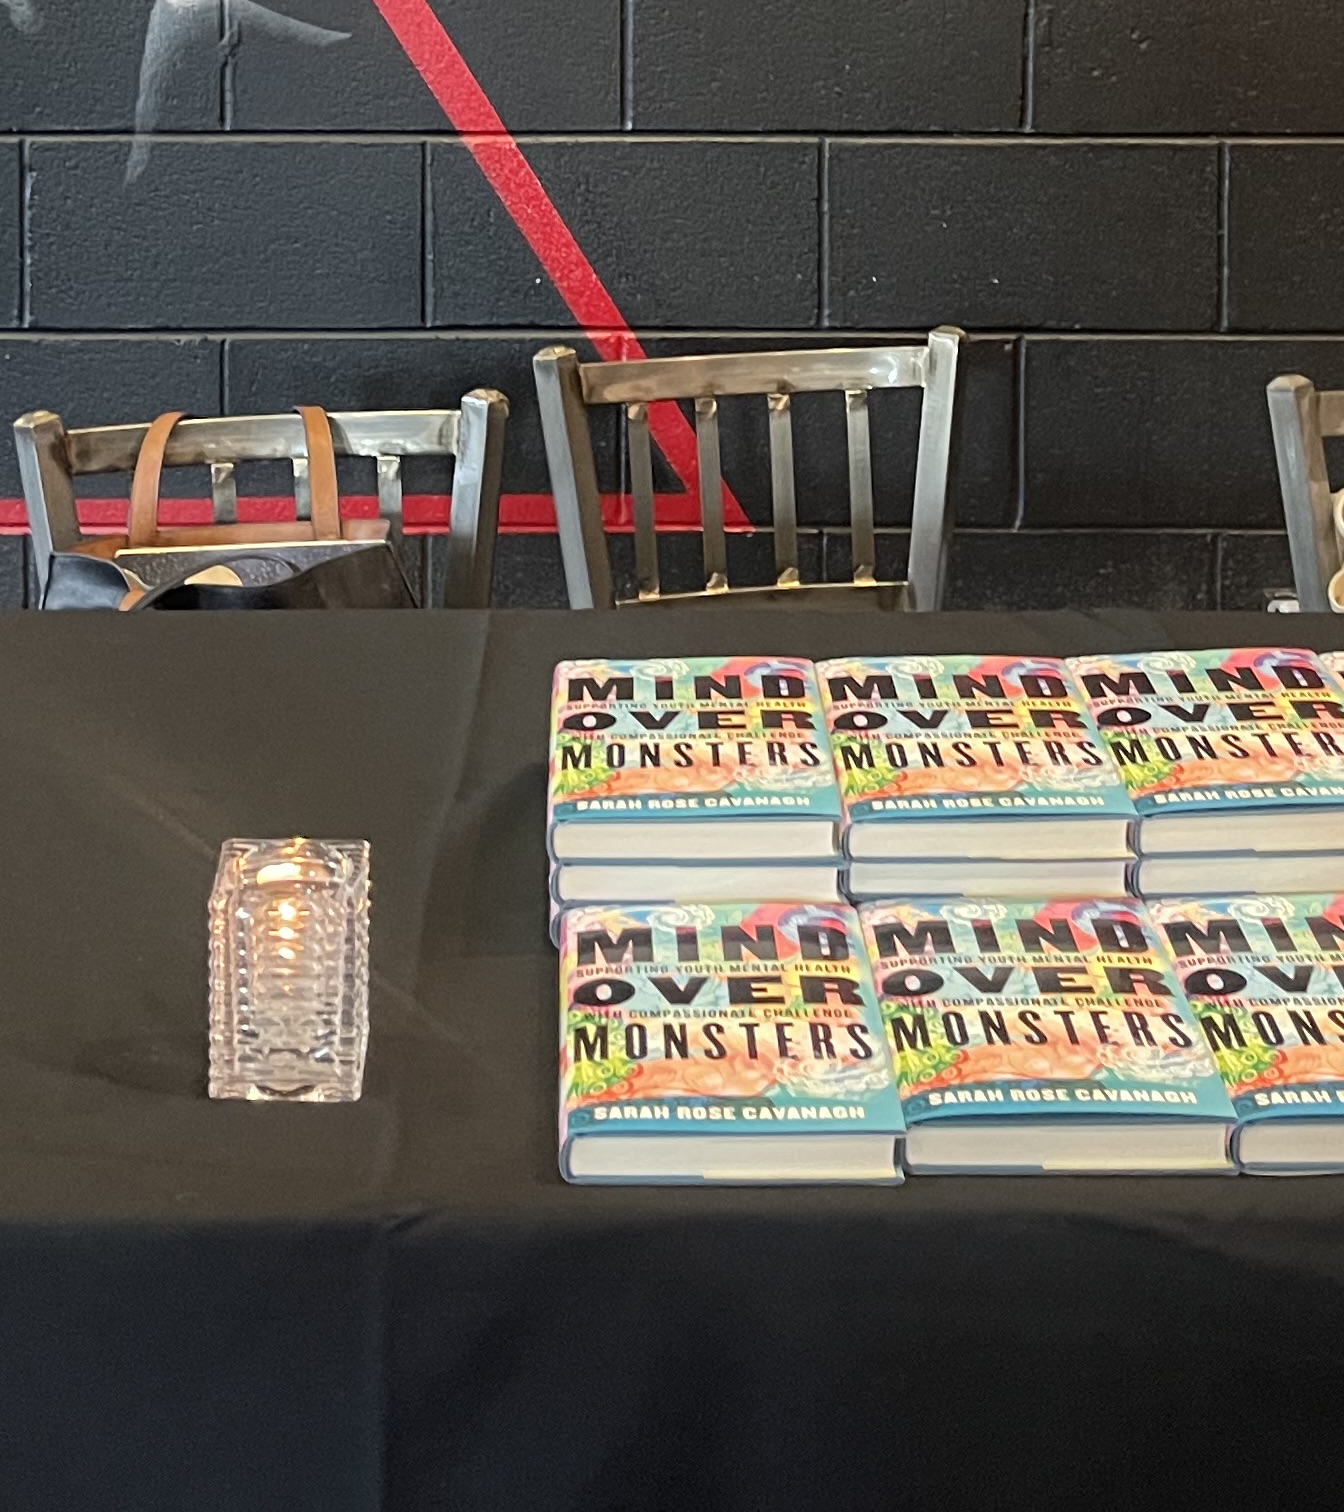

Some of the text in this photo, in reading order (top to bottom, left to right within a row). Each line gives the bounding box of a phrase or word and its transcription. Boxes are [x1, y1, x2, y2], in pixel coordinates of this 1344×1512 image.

[568, 675, 807, 701] MIND
[827, 674, 1068, 701] MIND
[1081, 666, 1325, 698] MIND
[564, 710, 816, 730] OVER
[834, 710, 1088, 730] OVER
[561, 743, 820, 769] MONSTERS
[841, 741, 1103, 770] MONSTERS
[577, 797, 810, 810] SARAH ROSE CAVANAGH
[872, 796, 1104, 810] SARAH ROSE CAVANAGH
[1154, 790, 1220, 804] SARAH
[1227, 788, 1276, 800] ROSE
[577, 925, 850, 964] MIND
[873, 919, 1149, 957] MIND
[574, 976, 867, 1007] OVER
[881, 966, 1175, 996] OVER
[573, 1023, 874, 1063] MONSTERS
[890, 1010, 1193, 1051] MONSTERS
[929, 1089, 1197, 1106] SARAH ROSE CAVANAGH
[1255, 1090, 1332, 1107] SARAH
[594, 1106, 865, 1121] SARAH ROSE CAVANAGH
